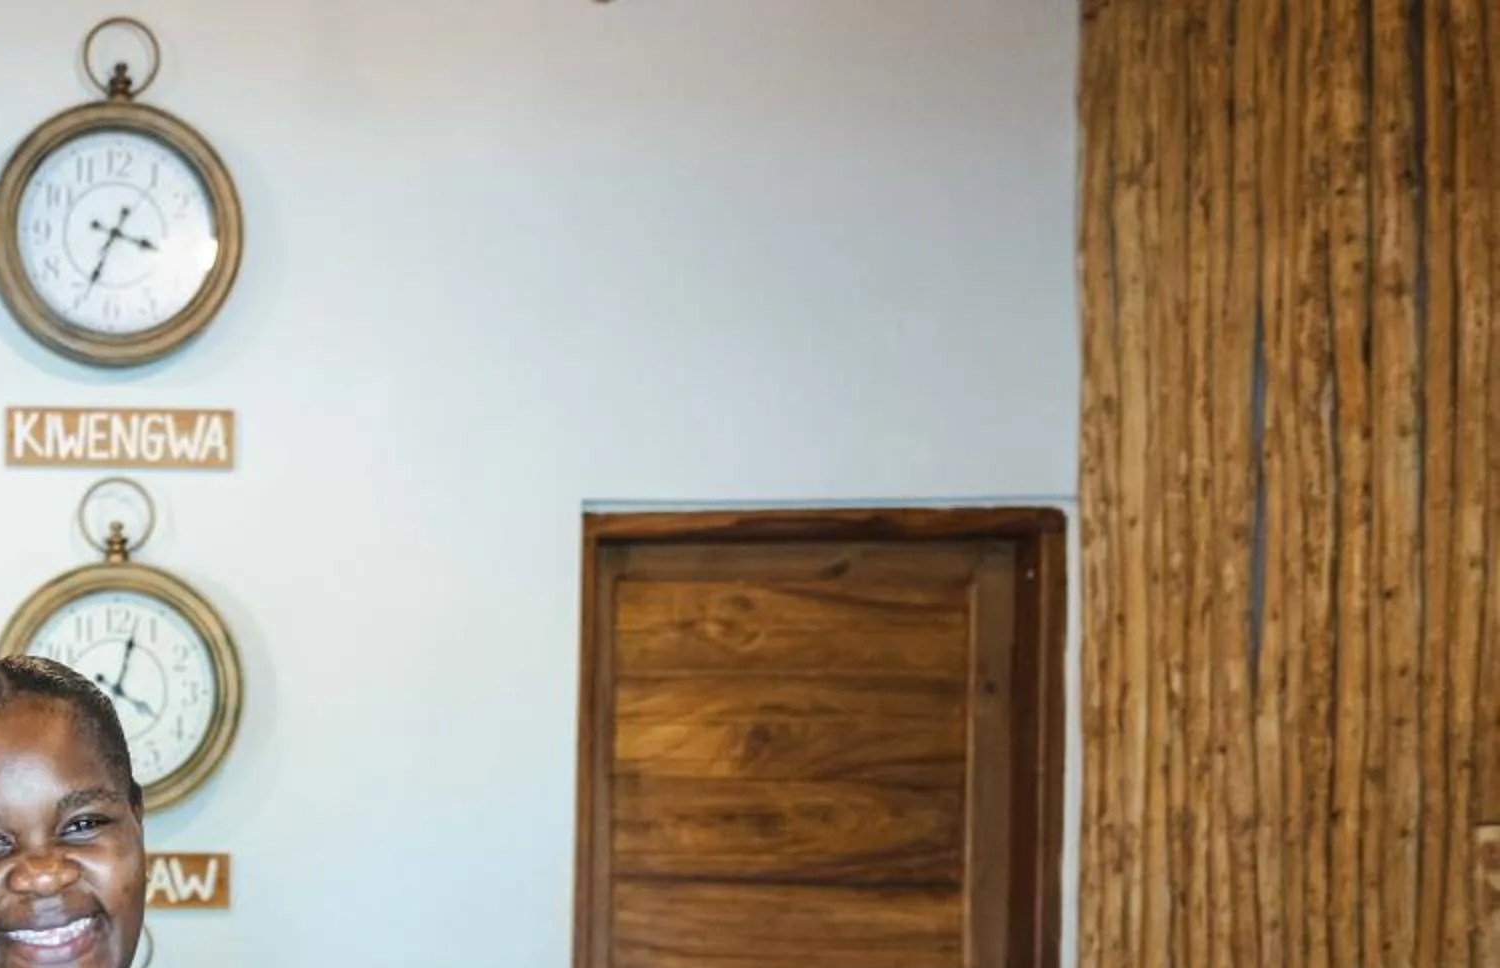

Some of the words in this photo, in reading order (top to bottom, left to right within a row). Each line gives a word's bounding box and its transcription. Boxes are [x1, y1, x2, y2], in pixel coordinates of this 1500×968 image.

[76, 156, 94, 184] 11
[106, 149, 133, 177] 12
[150, 162, 159, 188] 1
[46, 184, 74, 208] 10
[173, 192, 191, 219] 2
[32, 219, 52, 246] 9
[42, 256, 61, 280] 8
[13, 410, 228, 462] KIWENGWA
[76, 616, 93, 643] 11
[106, 606, 131, 634] 12
[150, 617, 158, 643] 1
[173, 644, 190, 672] 2
[180, 681, 199, 704] 3
[168, 714, 185, 742] 4
[145, 857, 218, 904] AW
